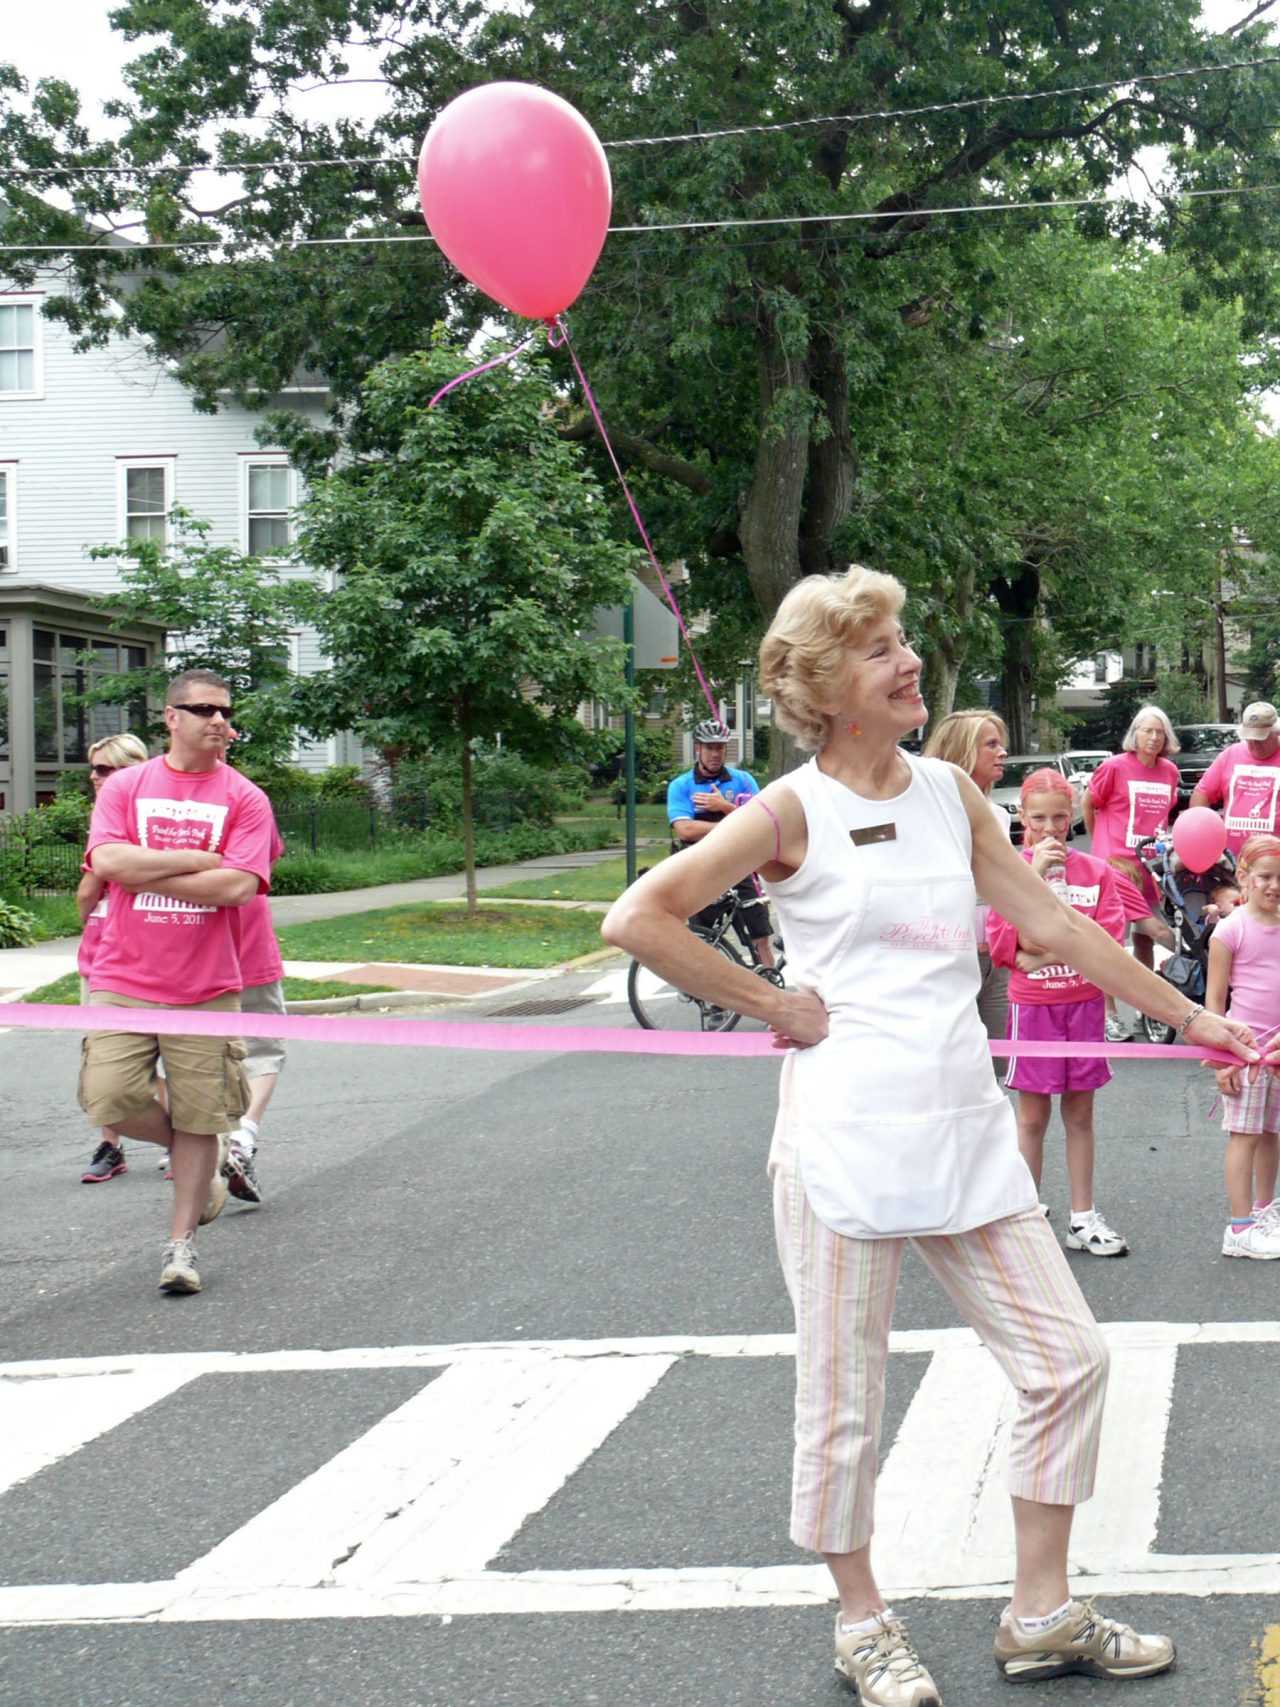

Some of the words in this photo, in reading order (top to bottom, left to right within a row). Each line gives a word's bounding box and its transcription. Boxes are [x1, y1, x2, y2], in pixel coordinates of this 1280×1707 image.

[143, 912, 168, 924] June
[171, 913, 180, 925] 5,
[1042, 979, 1067, 989] June
